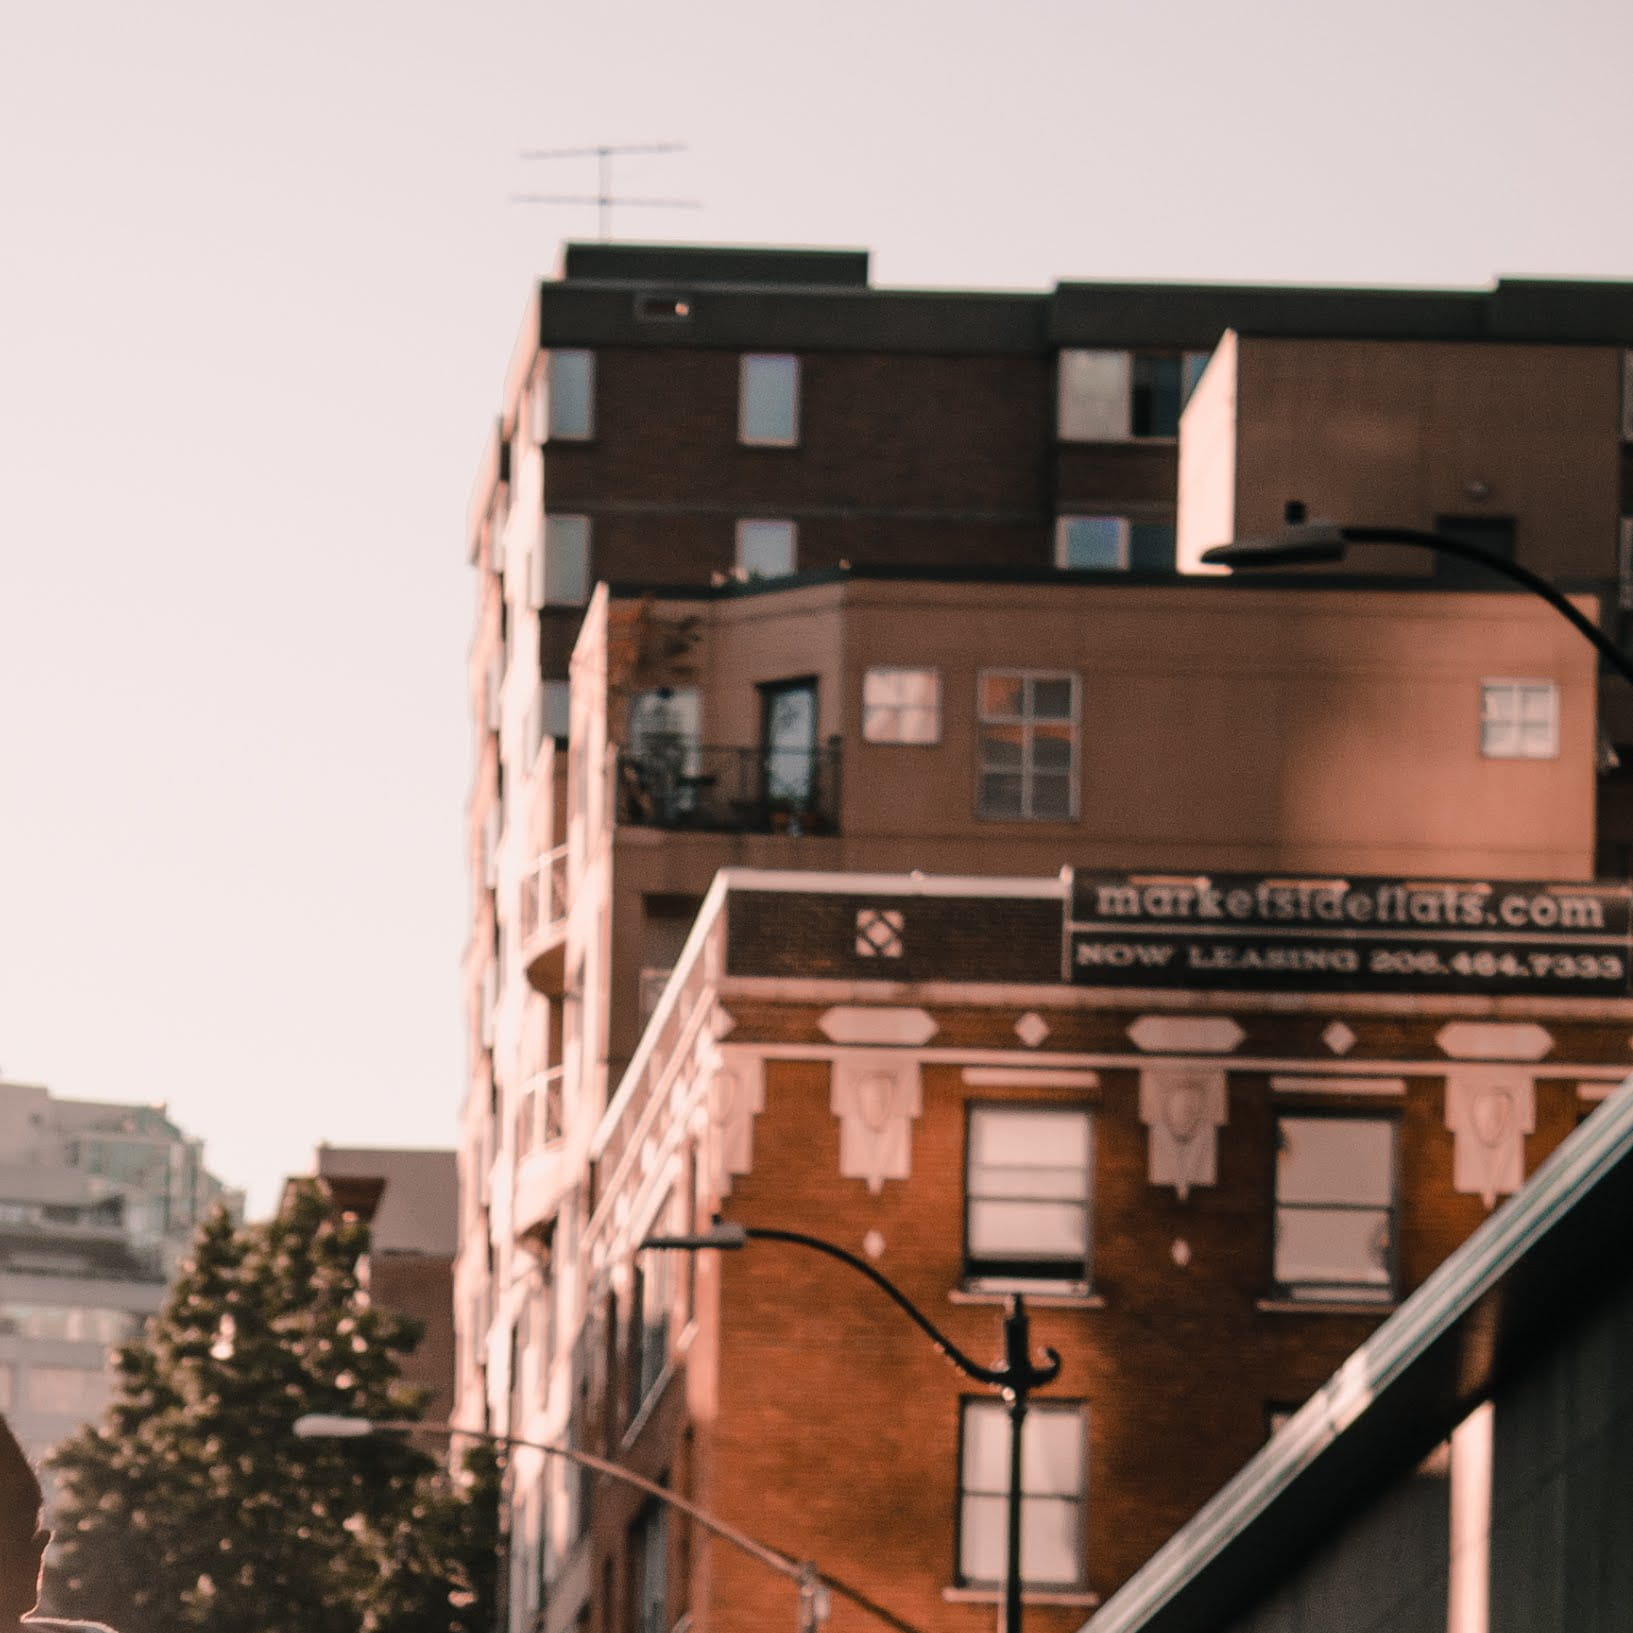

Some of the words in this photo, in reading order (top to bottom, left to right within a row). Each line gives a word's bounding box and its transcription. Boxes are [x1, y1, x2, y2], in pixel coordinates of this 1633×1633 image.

[1097, 881, 1604, 928] marketsideflats.com
[1076, 944, 1172, 967] NOW
[1188, 945, 1359, 973] LEASING
